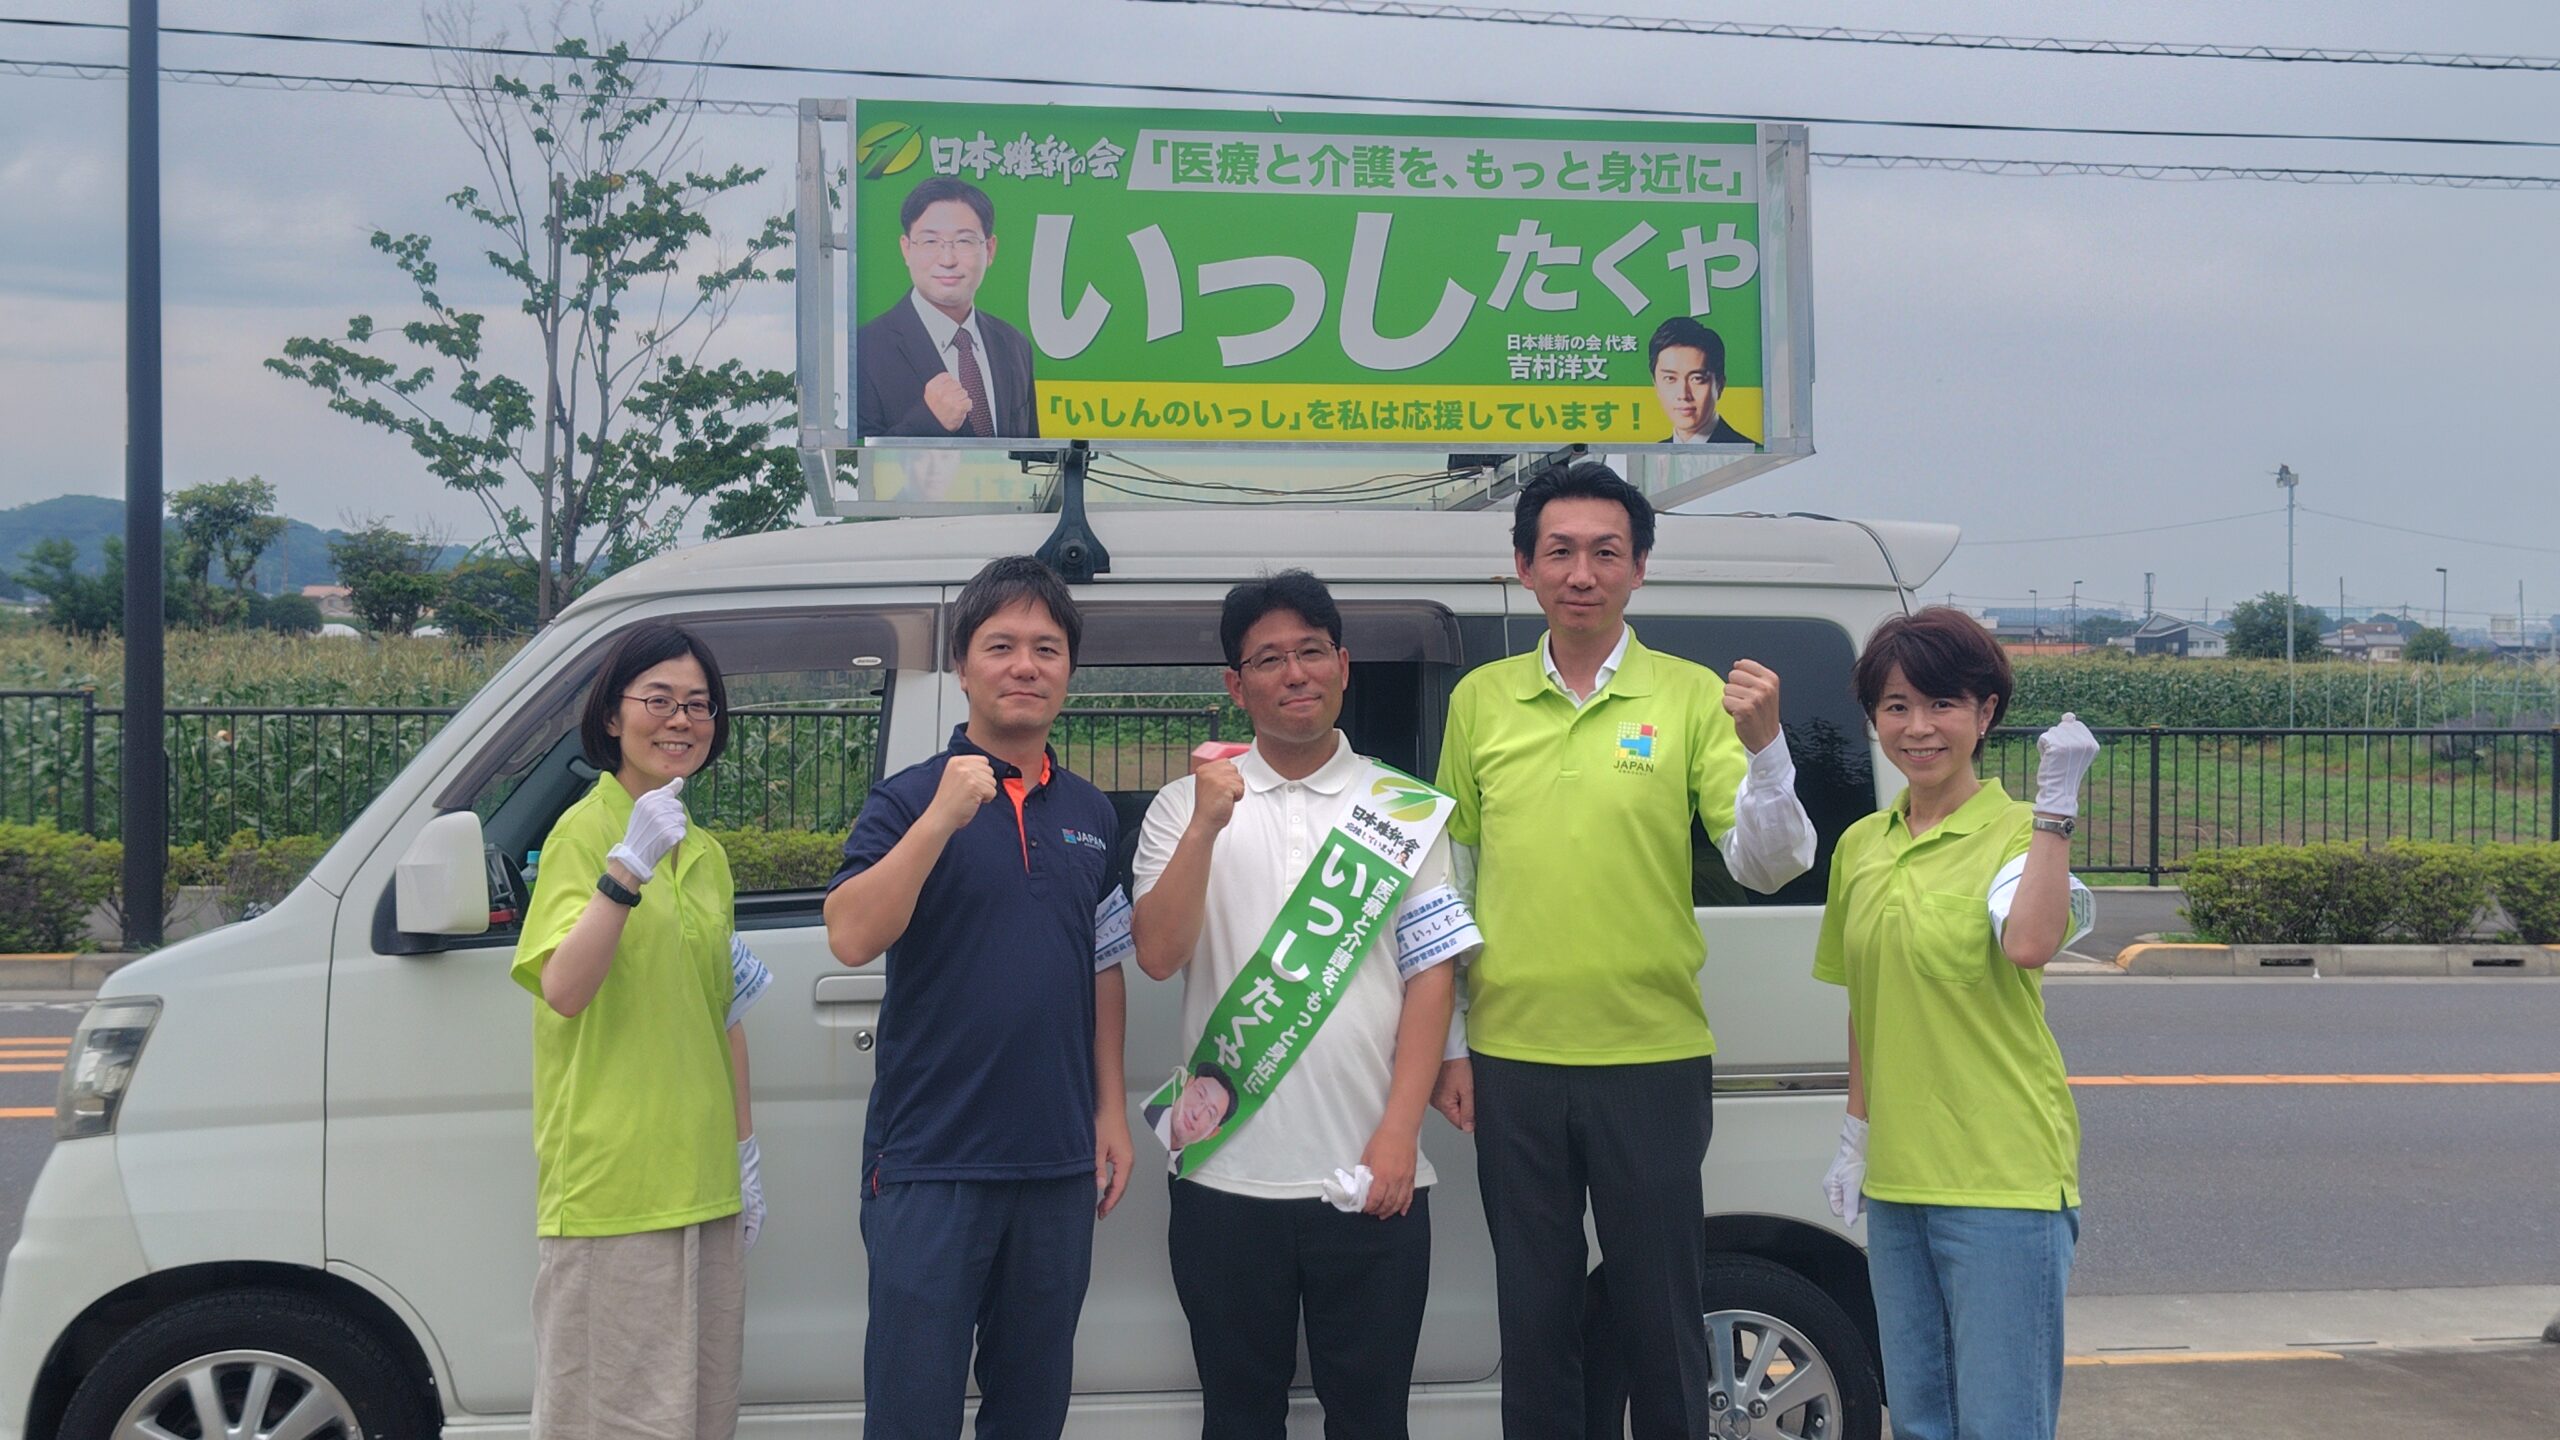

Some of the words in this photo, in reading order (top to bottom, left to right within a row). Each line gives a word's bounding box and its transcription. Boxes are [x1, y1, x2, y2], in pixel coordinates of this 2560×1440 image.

[930, 130, 1127, 185] 日本維新の会
[1153, 138, 1743, 197] 「医療と介護を、もっと身近に」
[1507, 354, 1609, 381] 吉村洋文
[1050, 395, 1642, 433] 「いしんのいっし」を私は応援しています！
[1613, 760, 1655, 773] JAPAN
[1076, 831, 1107, 851] JAPAN
[1352, 804, 1420, 855] 日本維新の会
